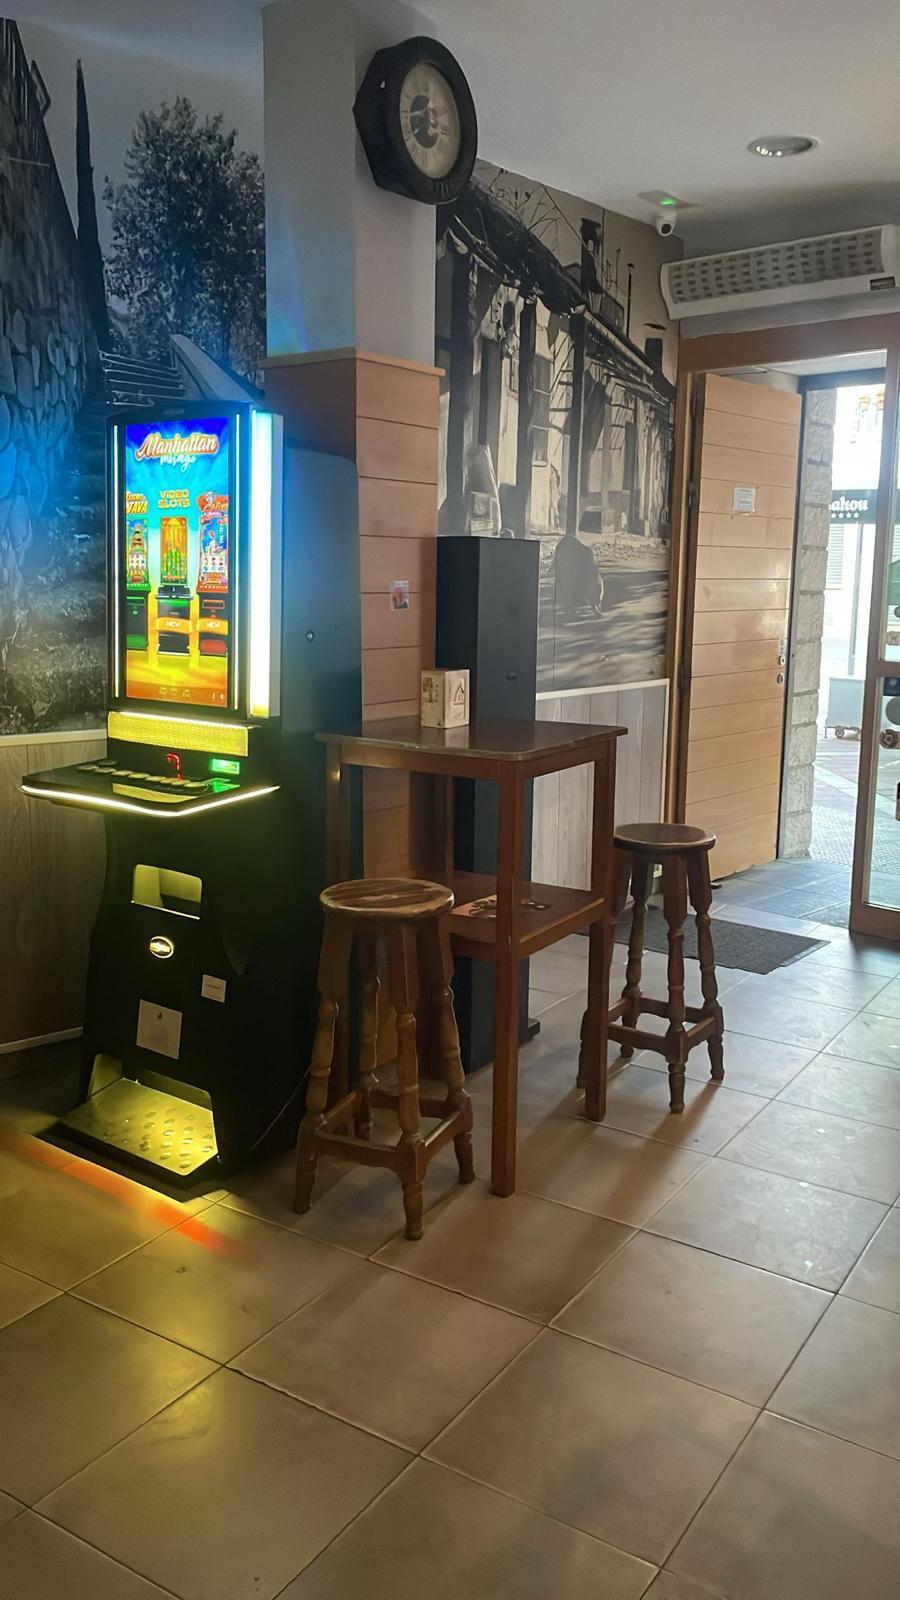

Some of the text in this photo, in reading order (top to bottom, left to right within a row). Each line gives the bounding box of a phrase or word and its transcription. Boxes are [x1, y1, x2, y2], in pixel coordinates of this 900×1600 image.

[137, 433, 218, 459] Manhattan
[160, 490, 189, 499] VIDEO
[158, 499, 191, 509] SLOTS
[828, 496, 869, 511] ahou
